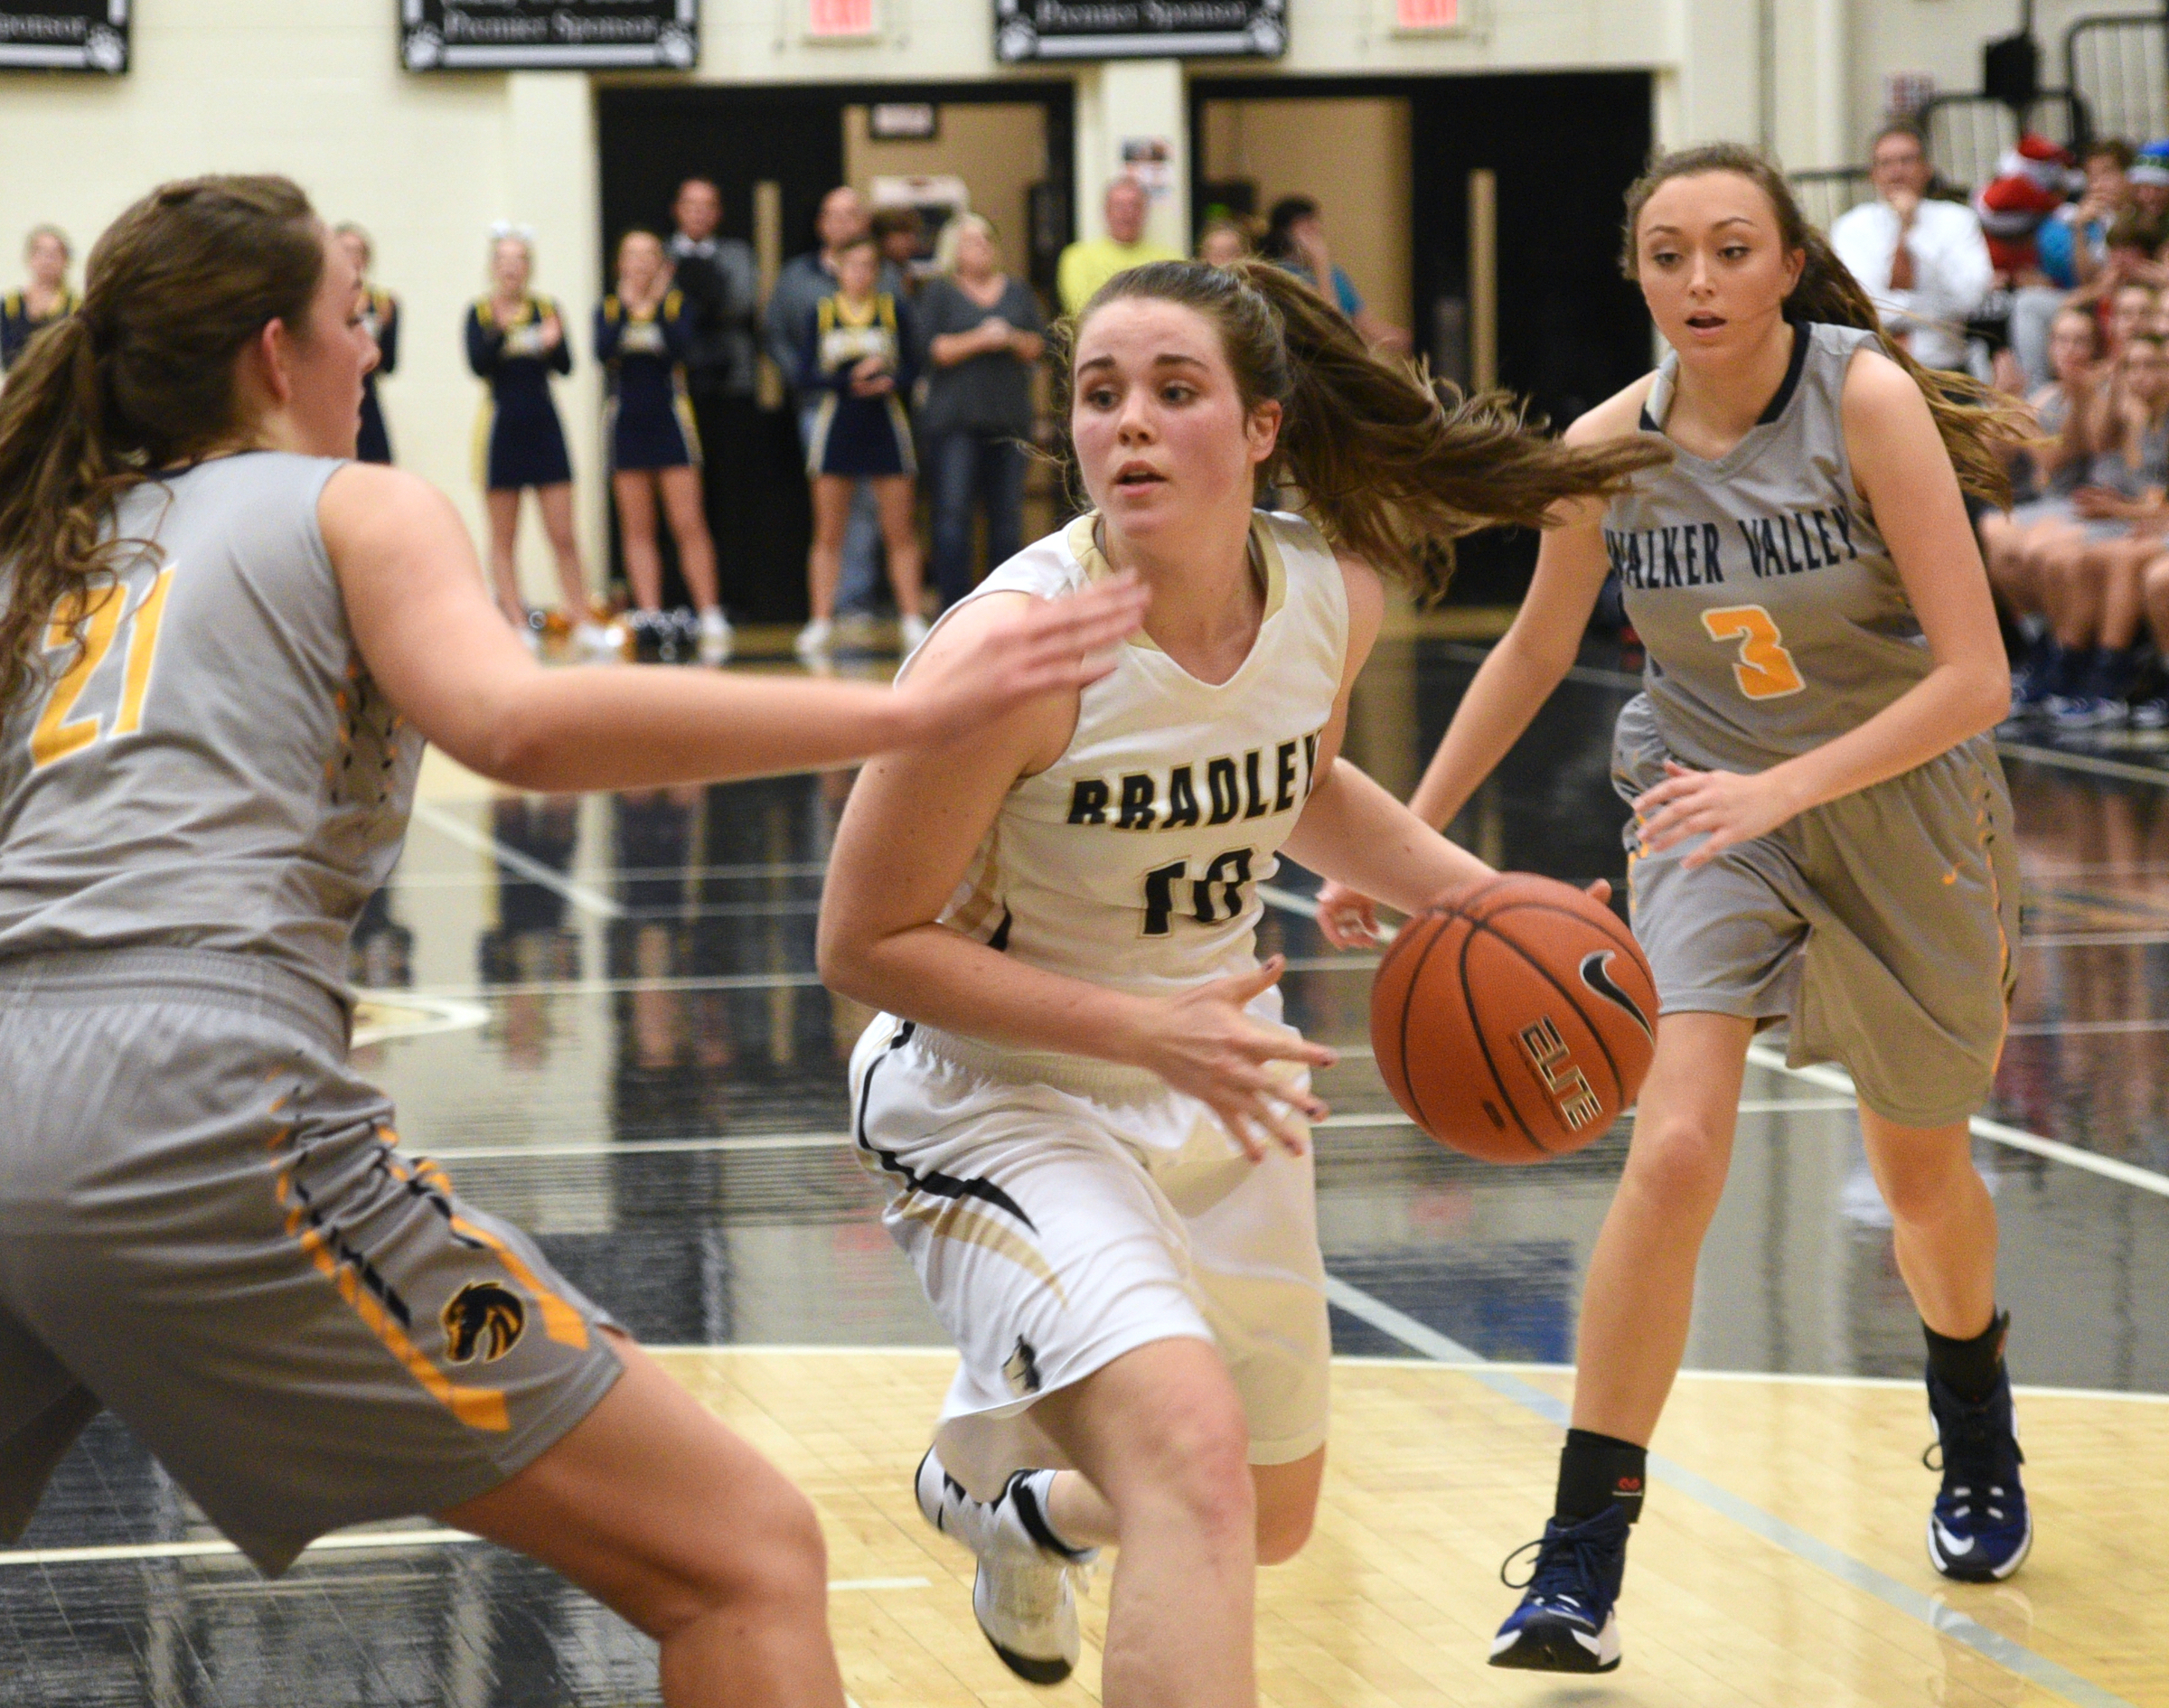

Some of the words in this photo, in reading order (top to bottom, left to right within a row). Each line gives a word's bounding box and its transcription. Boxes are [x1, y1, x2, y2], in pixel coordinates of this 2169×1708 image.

[1604, 522, 1724, 588] WALKER
[1737, 505, 1857, 578] VALLEY
[27, 562, 178, 772] 21
[1700, 604, 1806, 700] 3
[1066, 727, 1323, 831] BRADLEY
[1141, 845, 1256, 936] 10
[1519, 1014, 1603, 1131] ELITE
